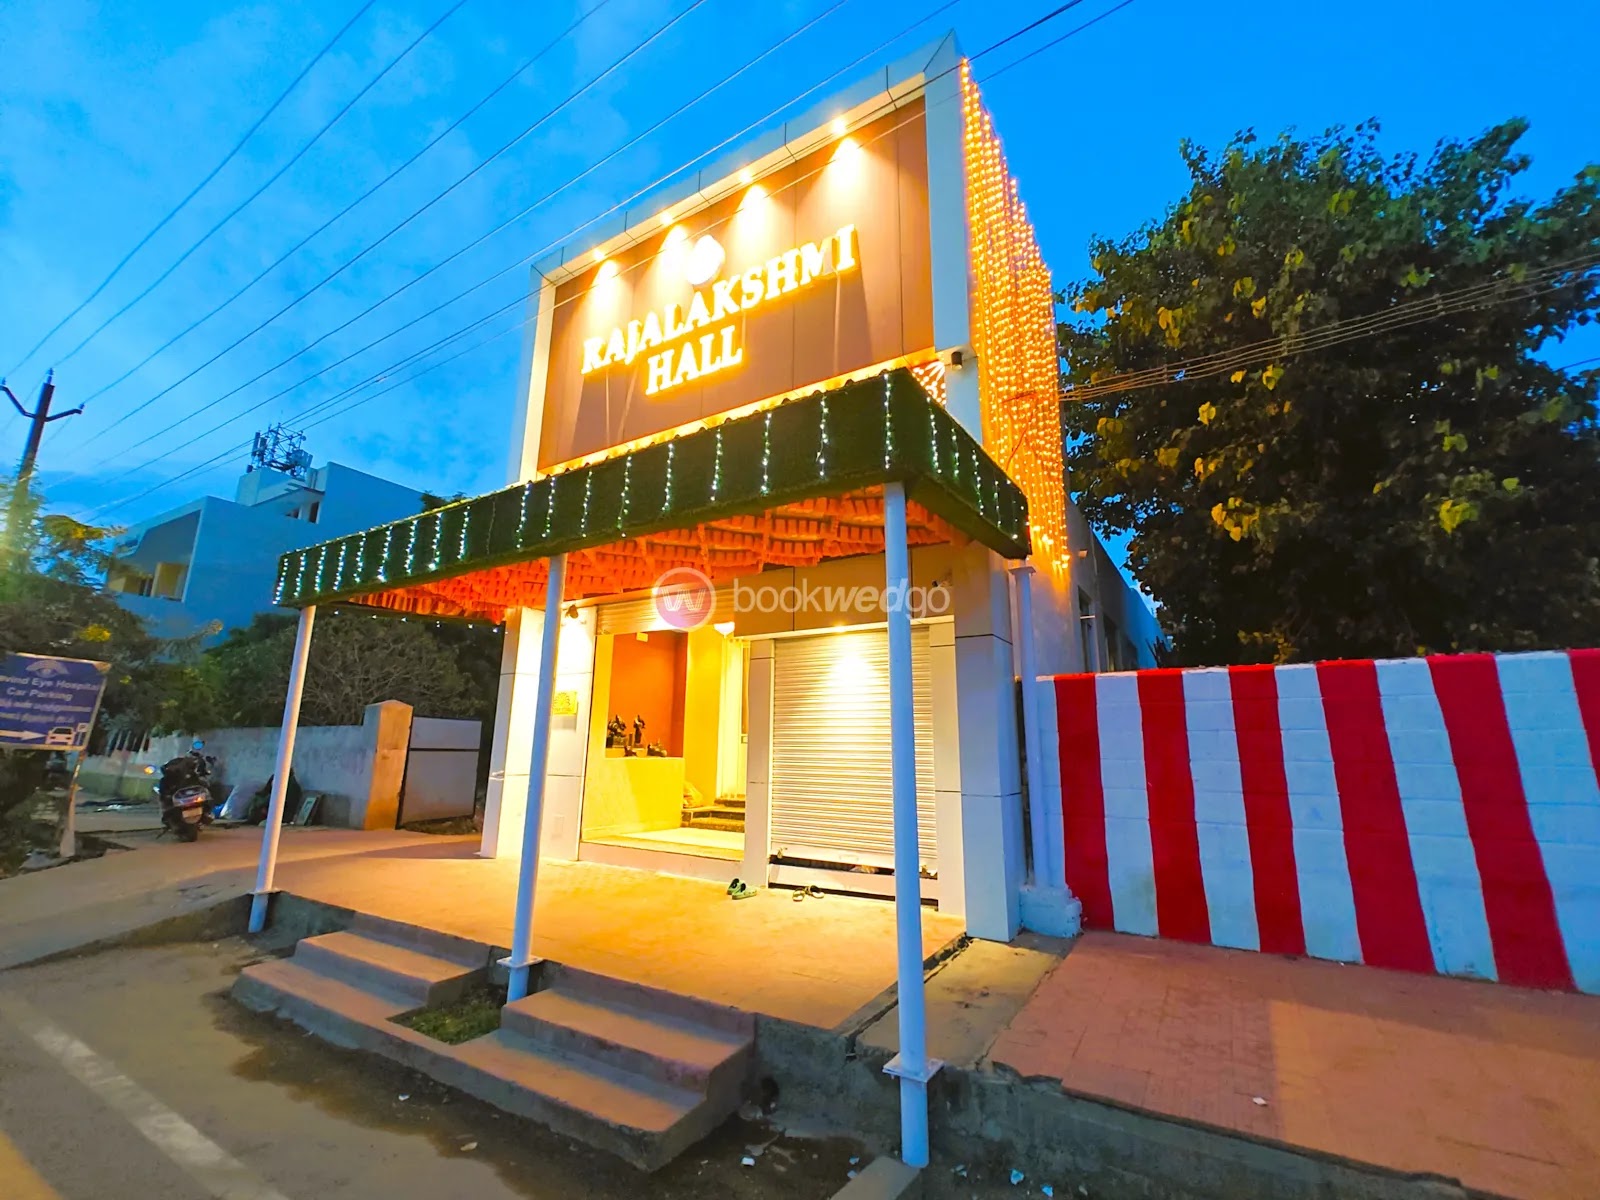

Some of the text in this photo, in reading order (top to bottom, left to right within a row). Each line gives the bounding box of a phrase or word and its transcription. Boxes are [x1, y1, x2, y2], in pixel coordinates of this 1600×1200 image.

[580, 223, 857, 375] RAJALAKSHMI
[645, 324, 743, 395] HALL
[6, 686, 74, 702] Car Parking
[32, 677, 53, 688] Eye
